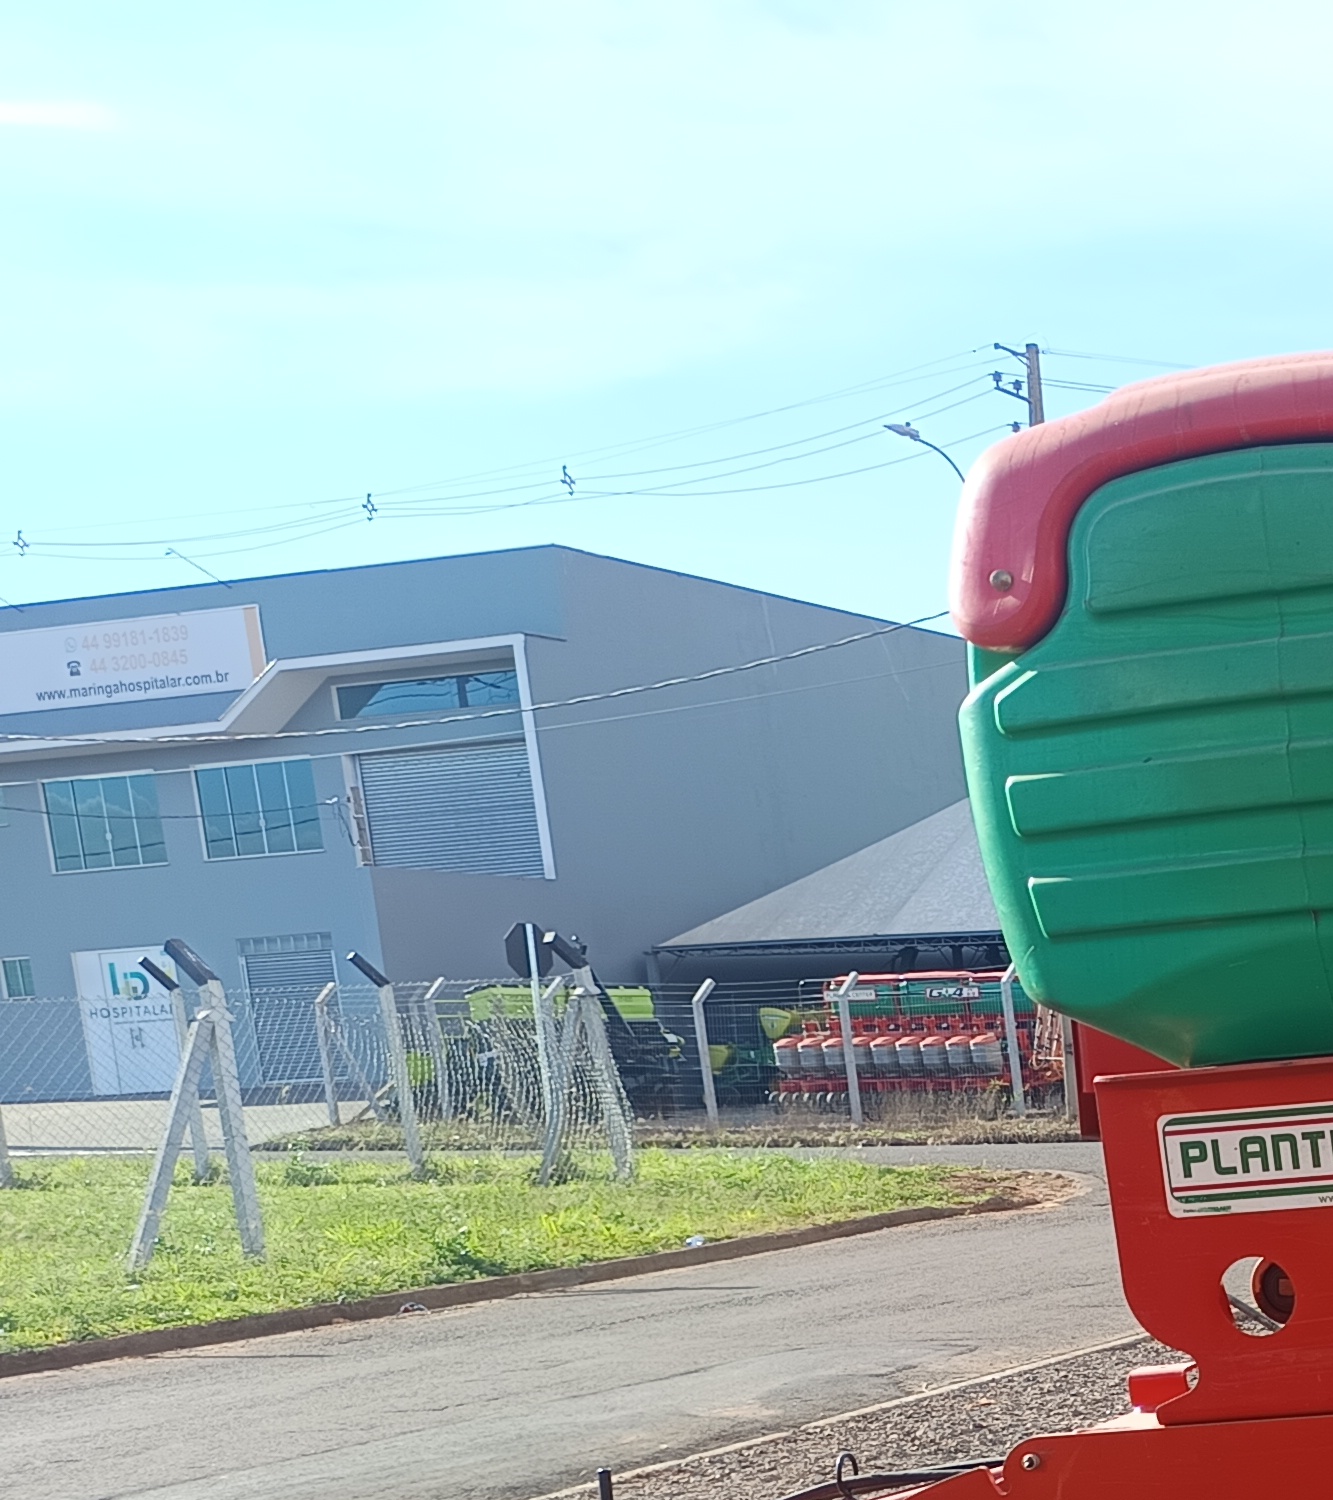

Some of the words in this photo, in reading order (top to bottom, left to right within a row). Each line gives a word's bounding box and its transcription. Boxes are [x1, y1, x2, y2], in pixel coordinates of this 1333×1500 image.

[81, 634, 99, 652] 44
[102, 624, 189, 649] 99181-1839
[89, 658, 108, 674] 44
[111, 649, 189, 671] 3200-0845
[36, 670, 230, 701] www.maringahospitalar.com.br
